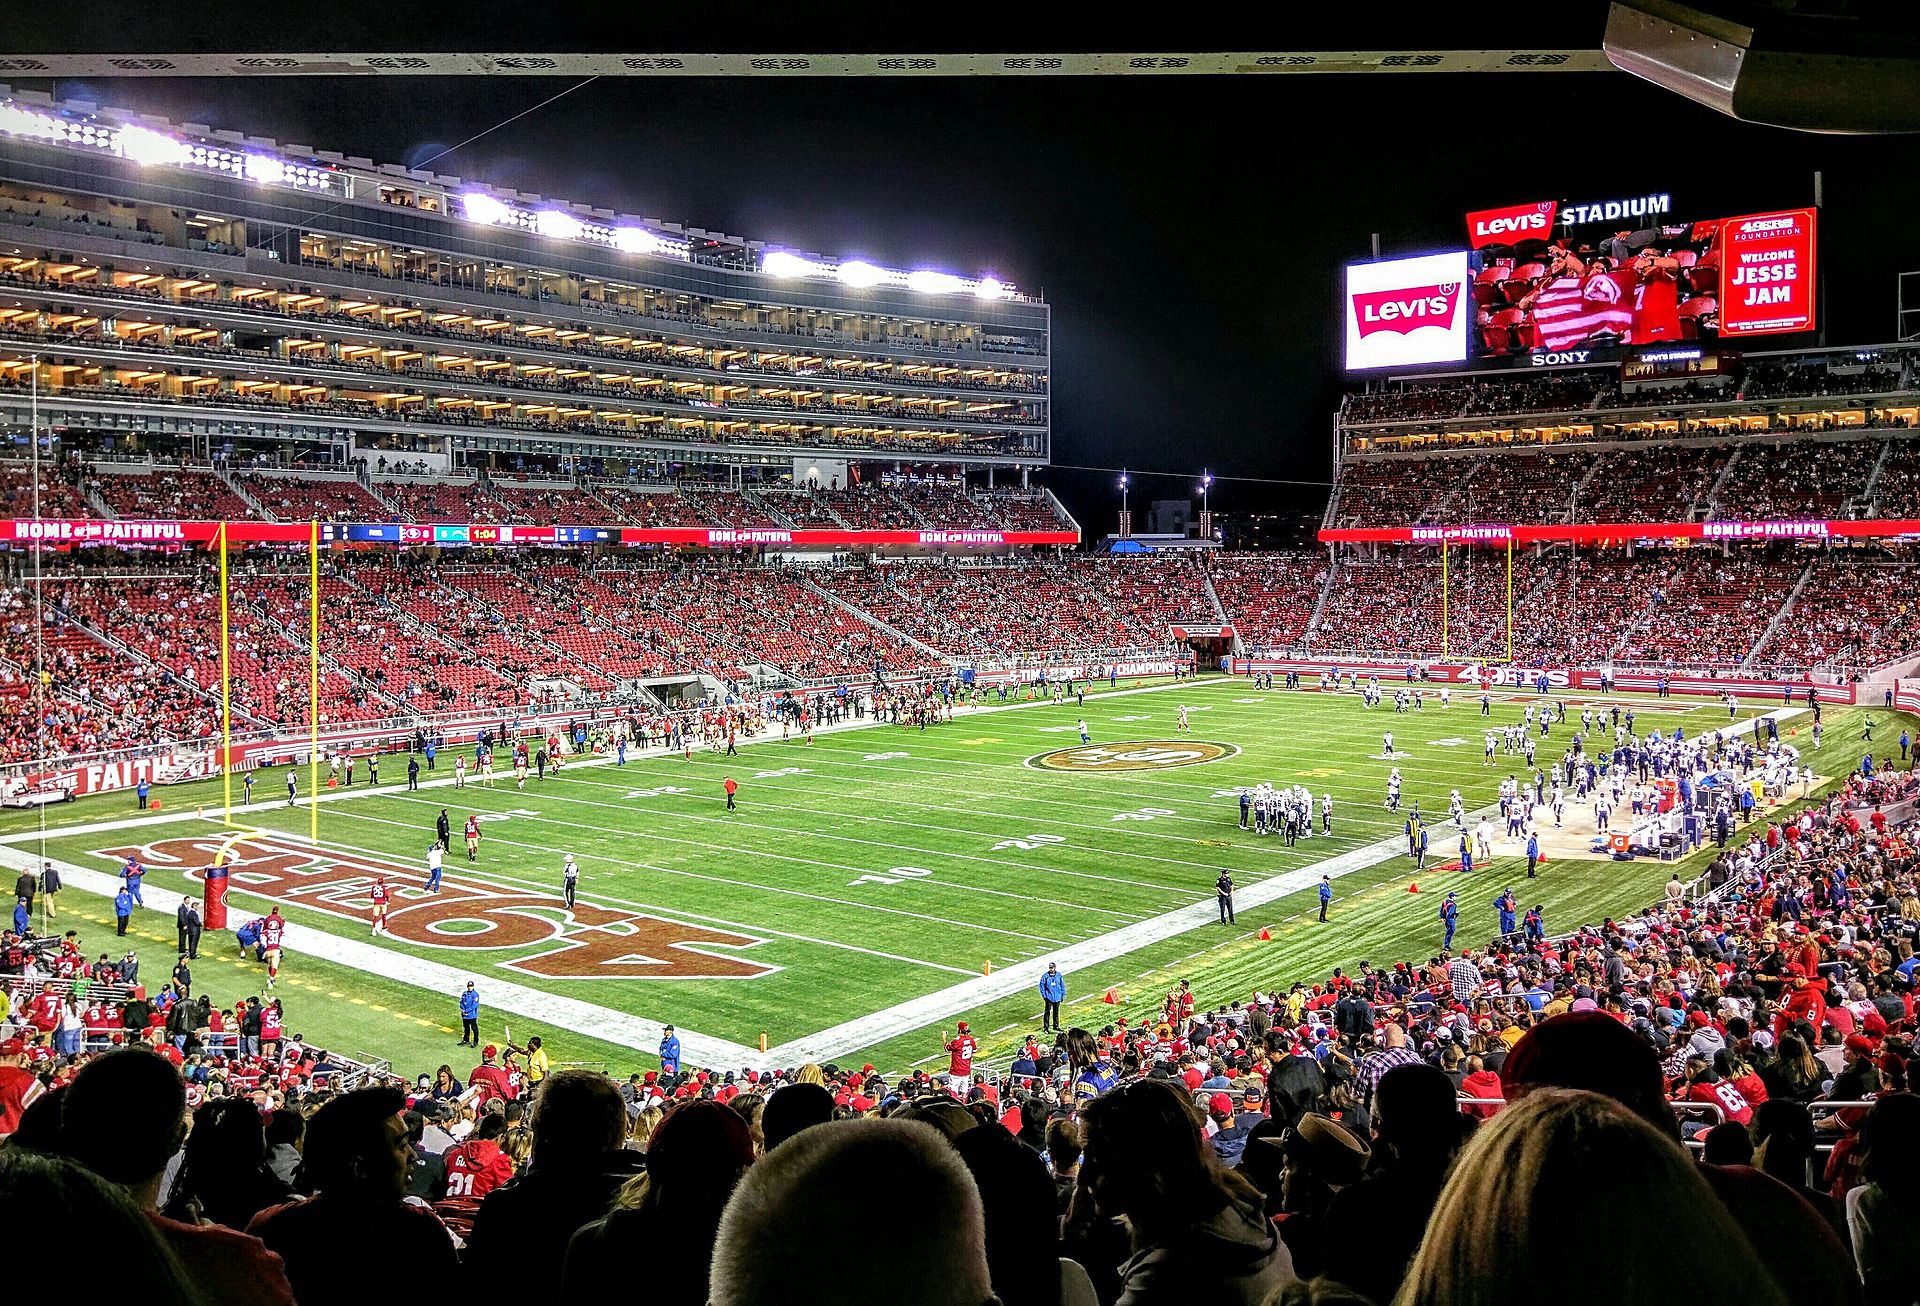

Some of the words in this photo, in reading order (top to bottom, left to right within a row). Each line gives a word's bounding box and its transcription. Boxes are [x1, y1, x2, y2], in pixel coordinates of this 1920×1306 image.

[1562, 195, 1668, 225] STADIUM
[1735, 228, 1801, 241] FOUNDATION
[1740, 249, 1795, 263] WELCOME
[1732, 263, 1797, 285] JESSE
[1744, 286, 1791, 306] JAM
[1532, 352, 1590, 366] SONY
[15, 522, 72, 538] HOME
[103, 523, 184, 538] FAITHFUL
[473, 529, 497, 539] 1:04
[1412, 529, 1443, 539] HOME
[1461, 528, 1512, 538] FAITHFUL
[1703, 524, 1742, 535] HOME
[1765, 522, 1828, 535] FAITHFUL
[708, 531, 737, 542] HOME
[920, 533, 947, 543] HOME
[962, 533, 1004, 543] FAITHFUL
[1116, 661, 1175, 675] CHAMPIONS
[1457, 665, 1569, 686] 49ERS
[988, 833, 1067, 851] 20
[1614, 837, 1625, 847] G
[47, 1001, 58, 1017] 7
